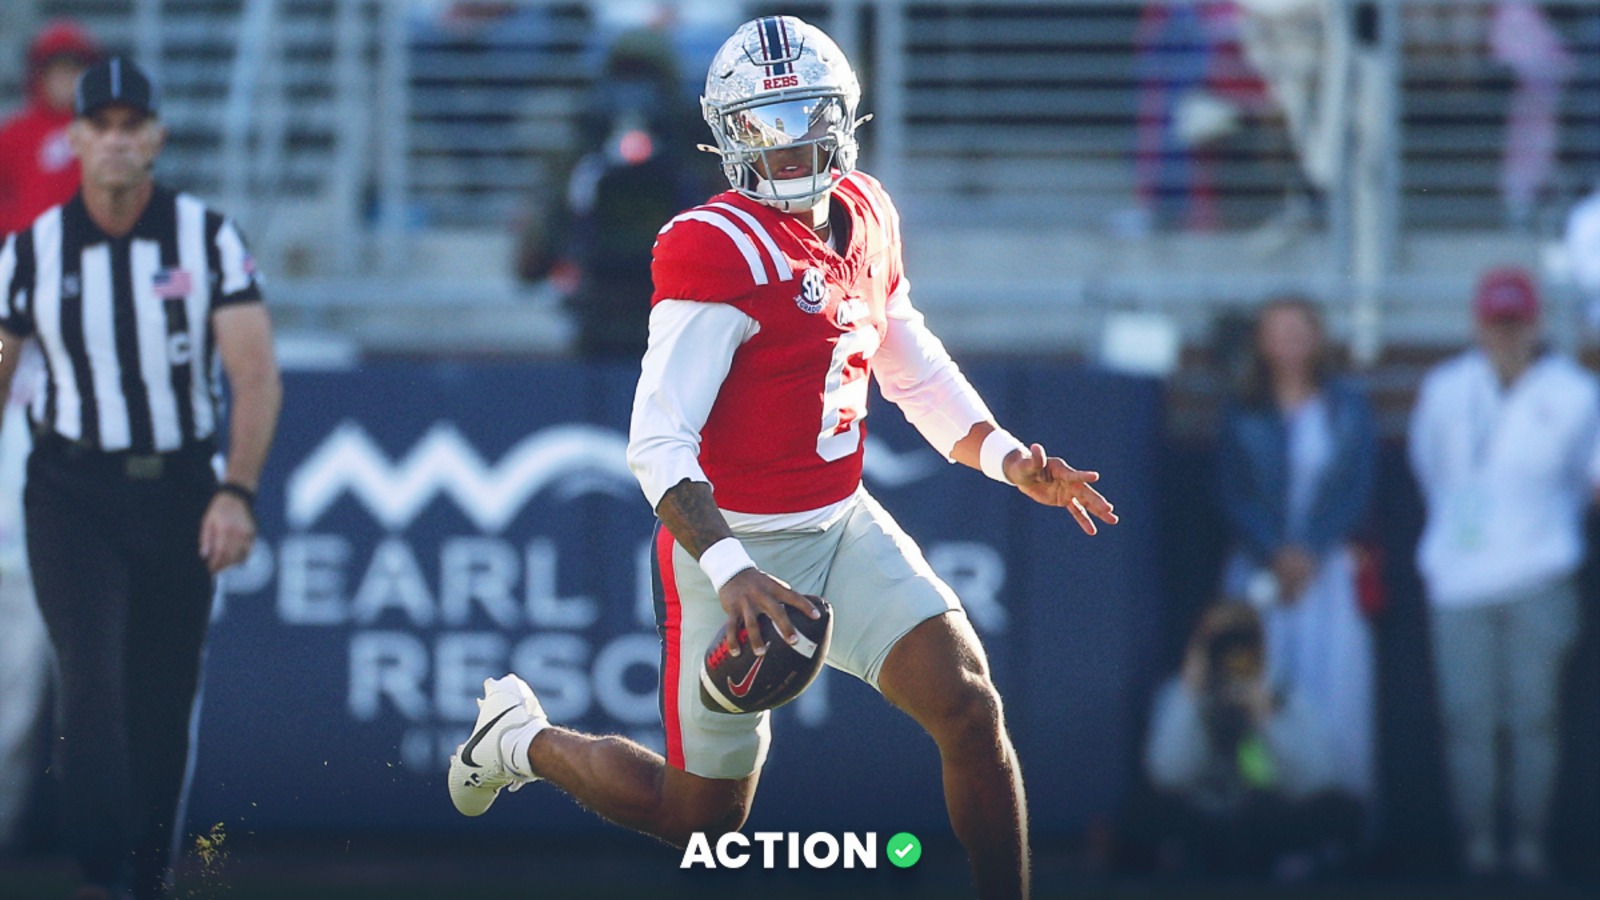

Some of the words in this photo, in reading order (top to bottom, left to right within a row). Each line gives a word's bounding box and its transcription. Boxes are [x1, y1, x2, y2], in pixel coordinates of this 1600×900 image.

[763, 75, 799, 91] REBS
[816, 325, 880, 463] 6
[208, 534, 597, 628] PEARL
